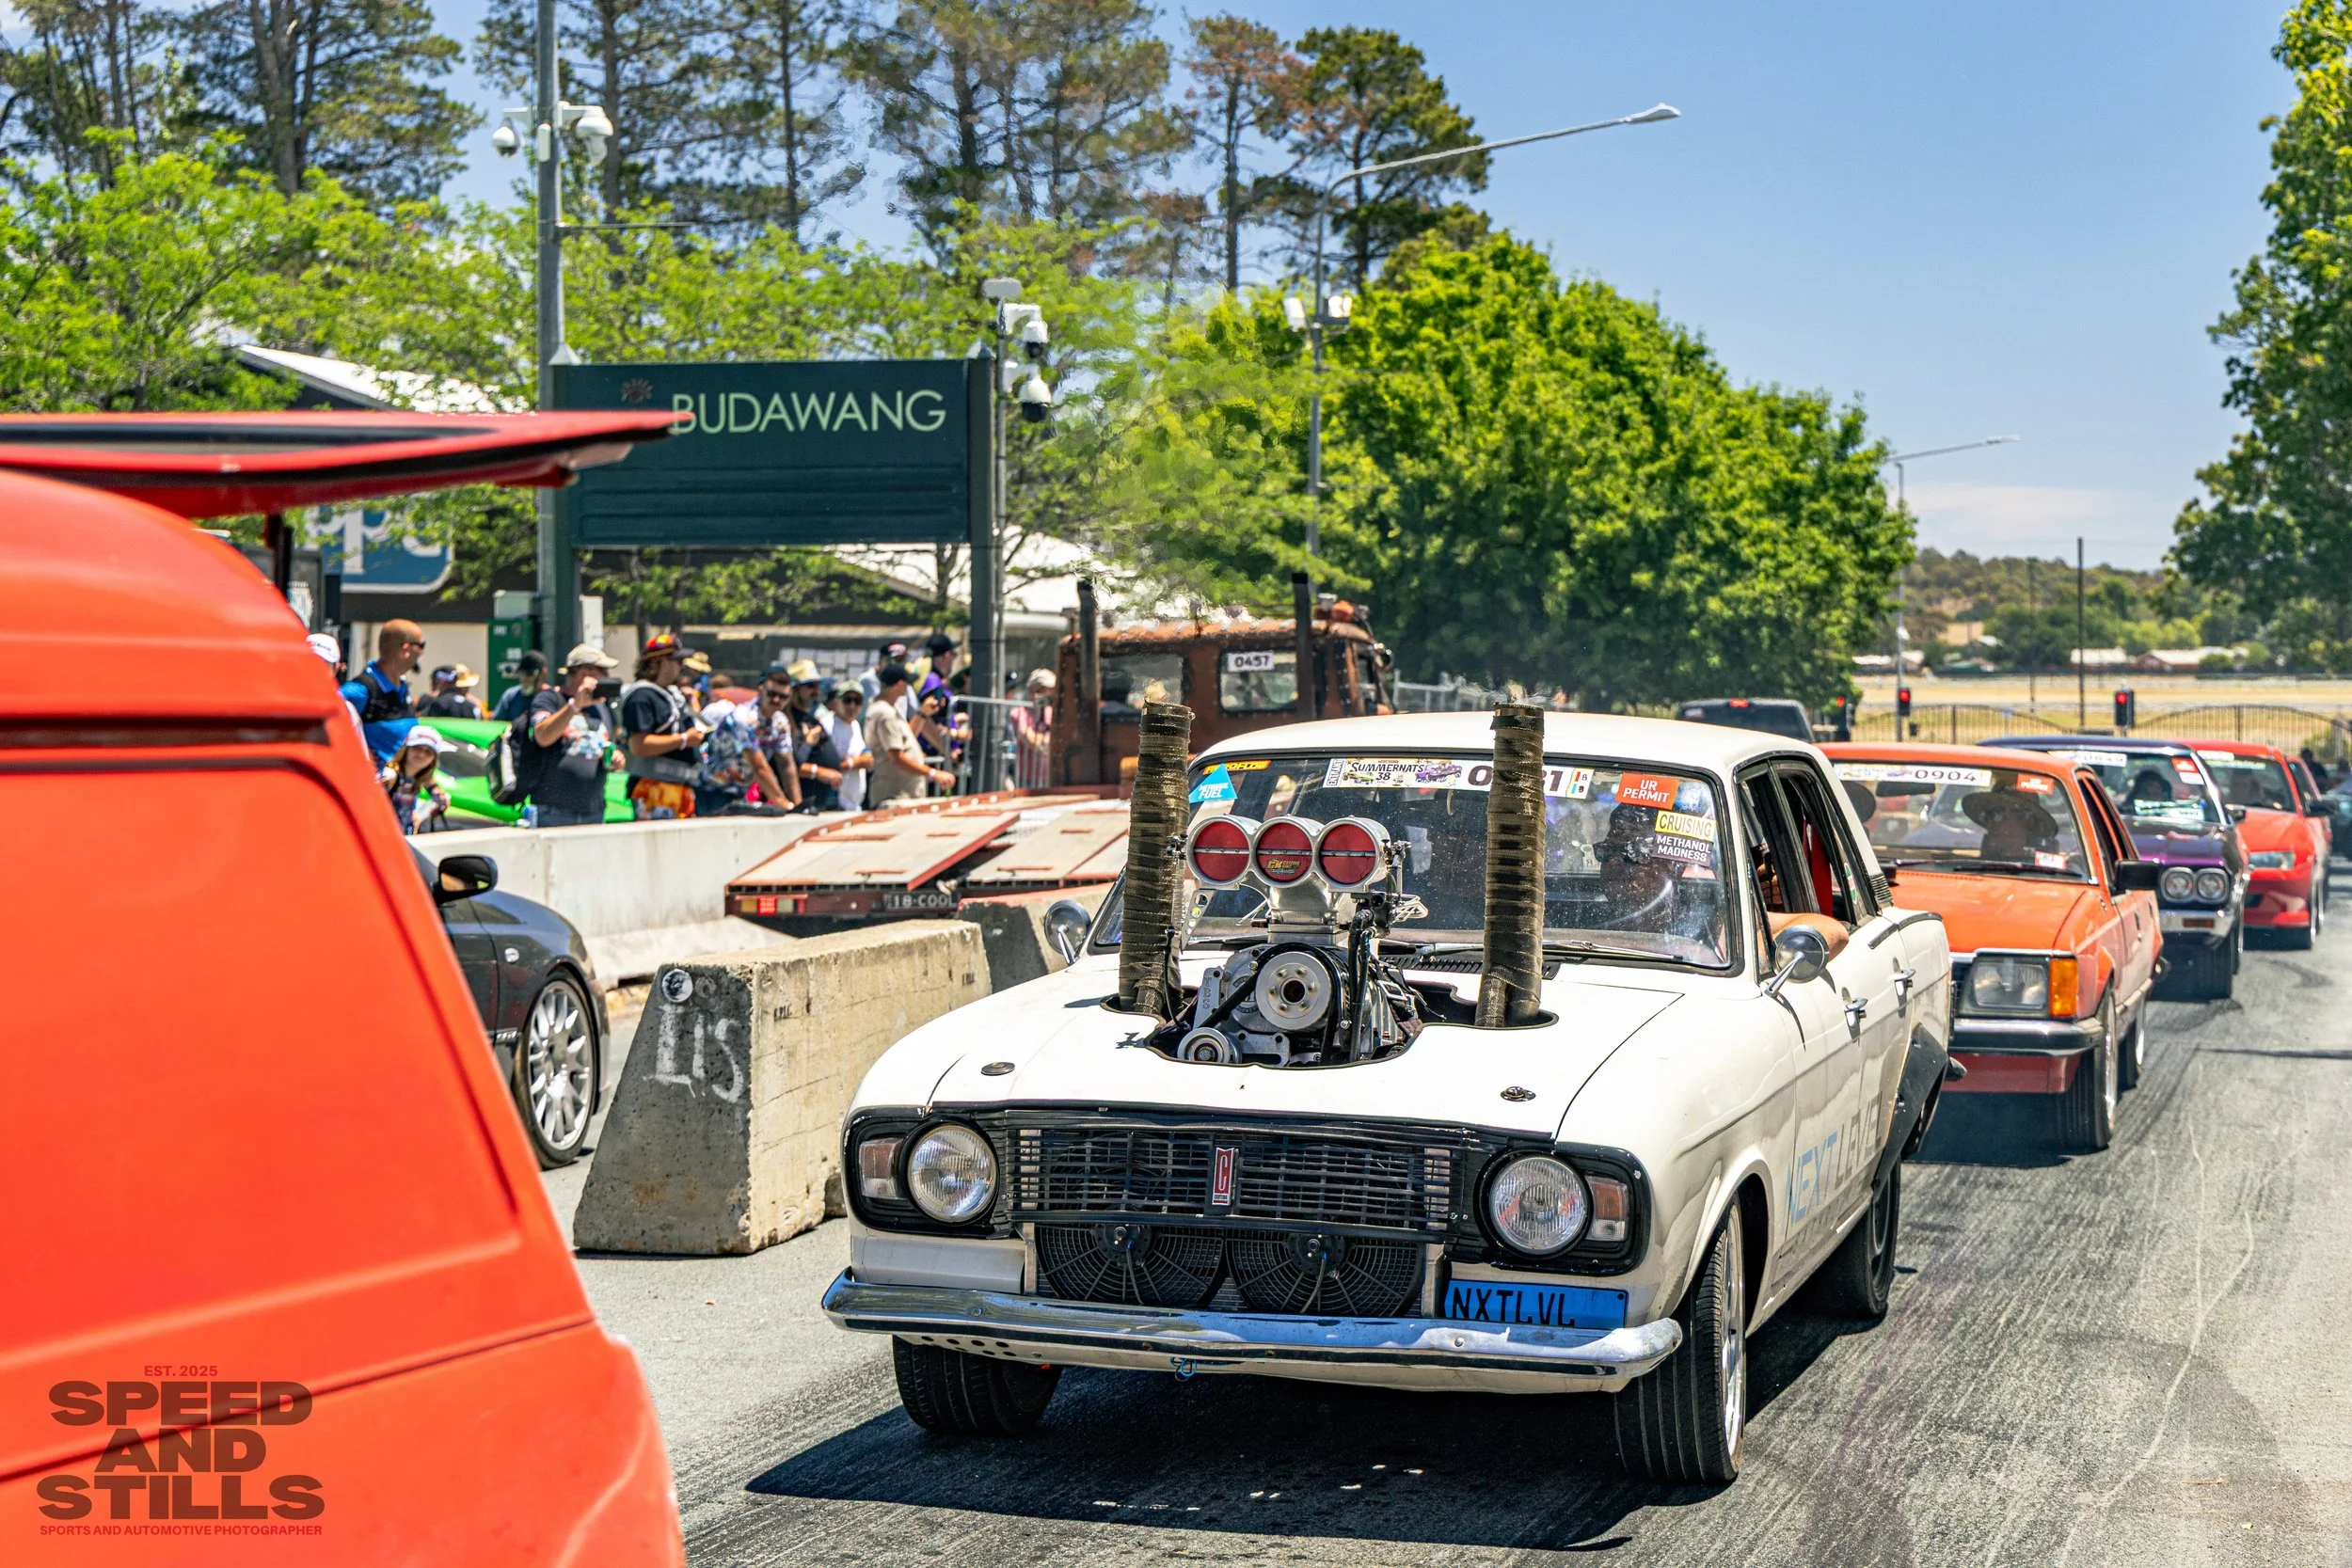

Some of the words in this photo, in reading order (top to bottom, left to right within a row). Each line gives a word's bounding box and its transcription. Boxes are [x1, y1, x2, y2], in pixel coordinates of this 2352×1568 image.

[672, 388, 946, 435] BUDAWANG
[1350, 762, 1425, 773] SUMMERNATS
[1915, 768, 1977, 782] 0904
[1375, 771, 1391, 781] 38
[1640, 779, 1658, 791] UR
[1198, 788, 1223, 800] FUEL
[1623, 787, 1670, 803] PERMIT
[1659, 814, 1712, 837] CRUISING
[1656, 834, 1711, 854] METHANOL
[1658, 846, 1708, 862] MADNESS
[1783, 1130, 1837, 1228] NEXT
[1835, 1090, 1883, 1190] LEVEL
[1452, 1287, 1575, 1328] NXTLVL
